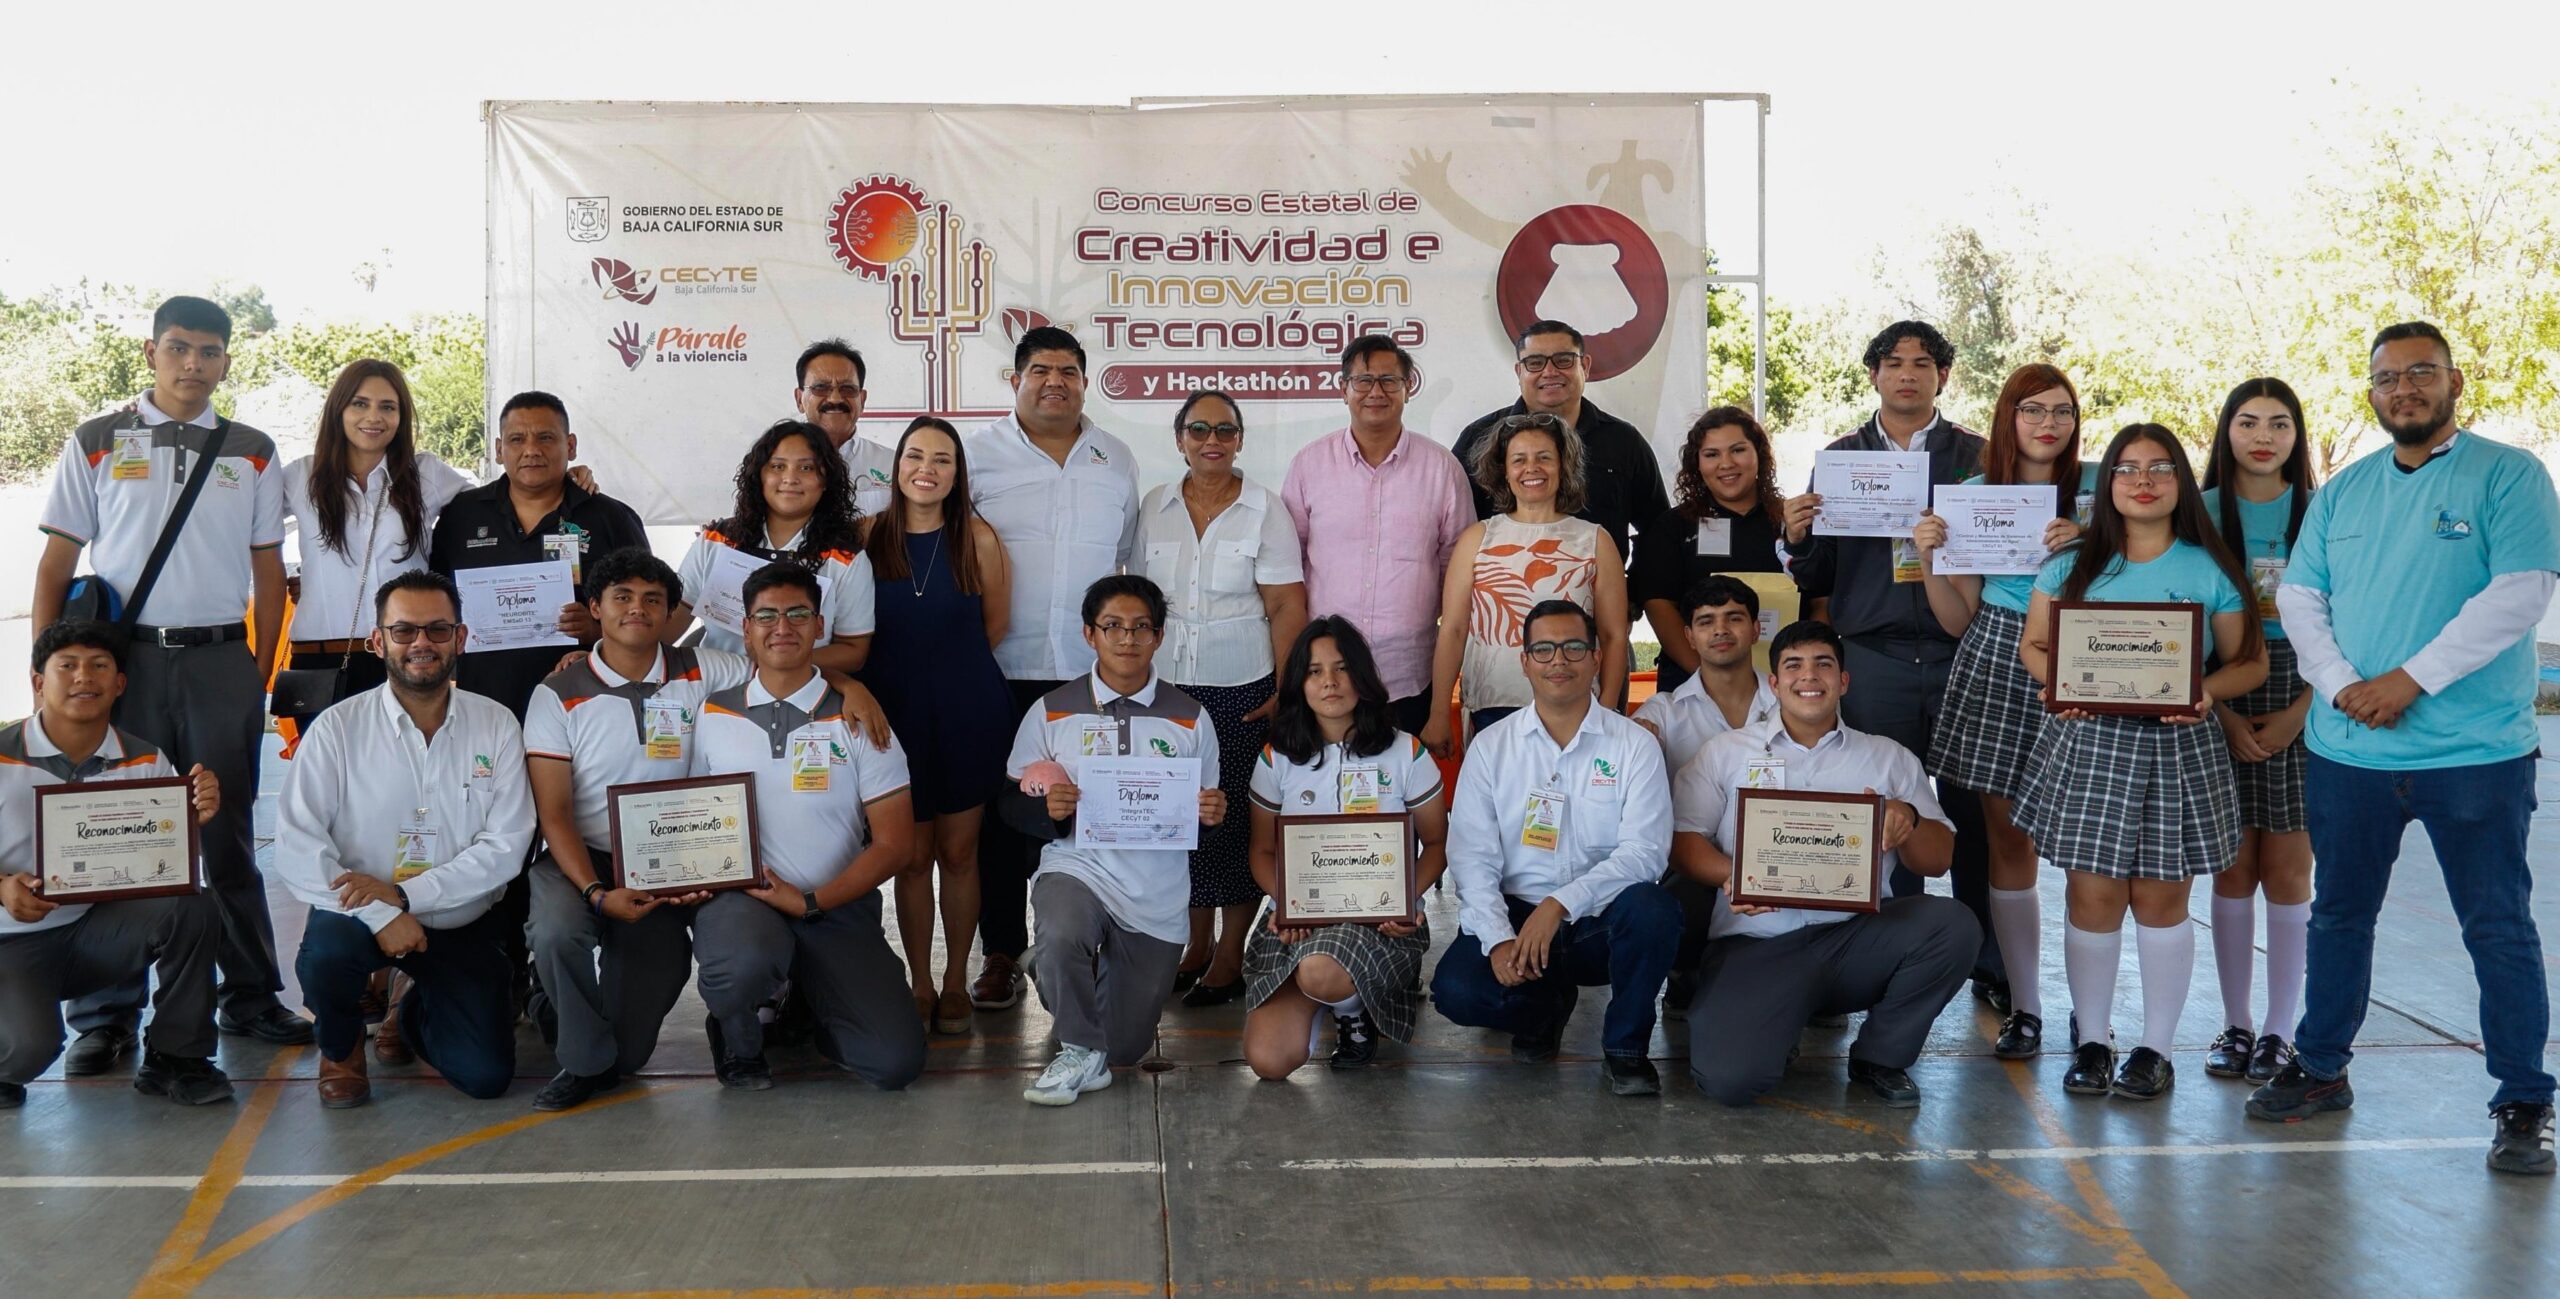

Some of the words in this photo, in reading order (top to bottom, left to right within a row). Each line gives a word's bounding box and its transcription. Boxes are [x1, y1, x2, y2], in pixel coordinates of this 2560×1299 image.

[622, 206, 686, 217] GOBIERNO
[689, 206, 713, 216] DEL
[716, 206, 764, 216] ESTADO
[767, 206, 784, 216] DE
[1097, 191, 1252, 213] Concurso
[1261, 192, 1370, 213] Estatal
[1378, 191, 1418, 212] de
[622, 221, 661, 233] BAJA
[664, 220, 750, 232] CALIFORNIA
[753, 221, 783, 232] SUR
[1077, 228, 1387, 263] Creatividad
[1407, 235, 1440, 260] e
[660, 267, 757, 283] CECyTE
[674, 285, 694, 296] Baja
[696, 284, 738, 294] California
[741, 284, 756, 293] Sur
[1110, 266, 1410, 305] Innovación
[656, 323, 747, 351] Párale
[656, 354, 664, 362] a
[668, 351, 680, 362] la
[685, 350, 748, 362] violencia
[1143, 376, 1159, 395] y
[1167, 370, 1310, 391] Hackathón
[1850, 478, 1890, 496] Diploma
[1973, 514, 2015, 533] Diploma
[496, 592, 536, 610] Diploma
[2087, 635, 2163, 654] Reconocimiento
[1118, 787, 1160, 806] Diploma
[76, 819, 157, 840] Reconocimiento
[648, 815, 721, 837] Reconocimiento
[1772, 827, 1845, 849] Reconocimiento
[1311, 851, 1379, 869] Reconocimiento
